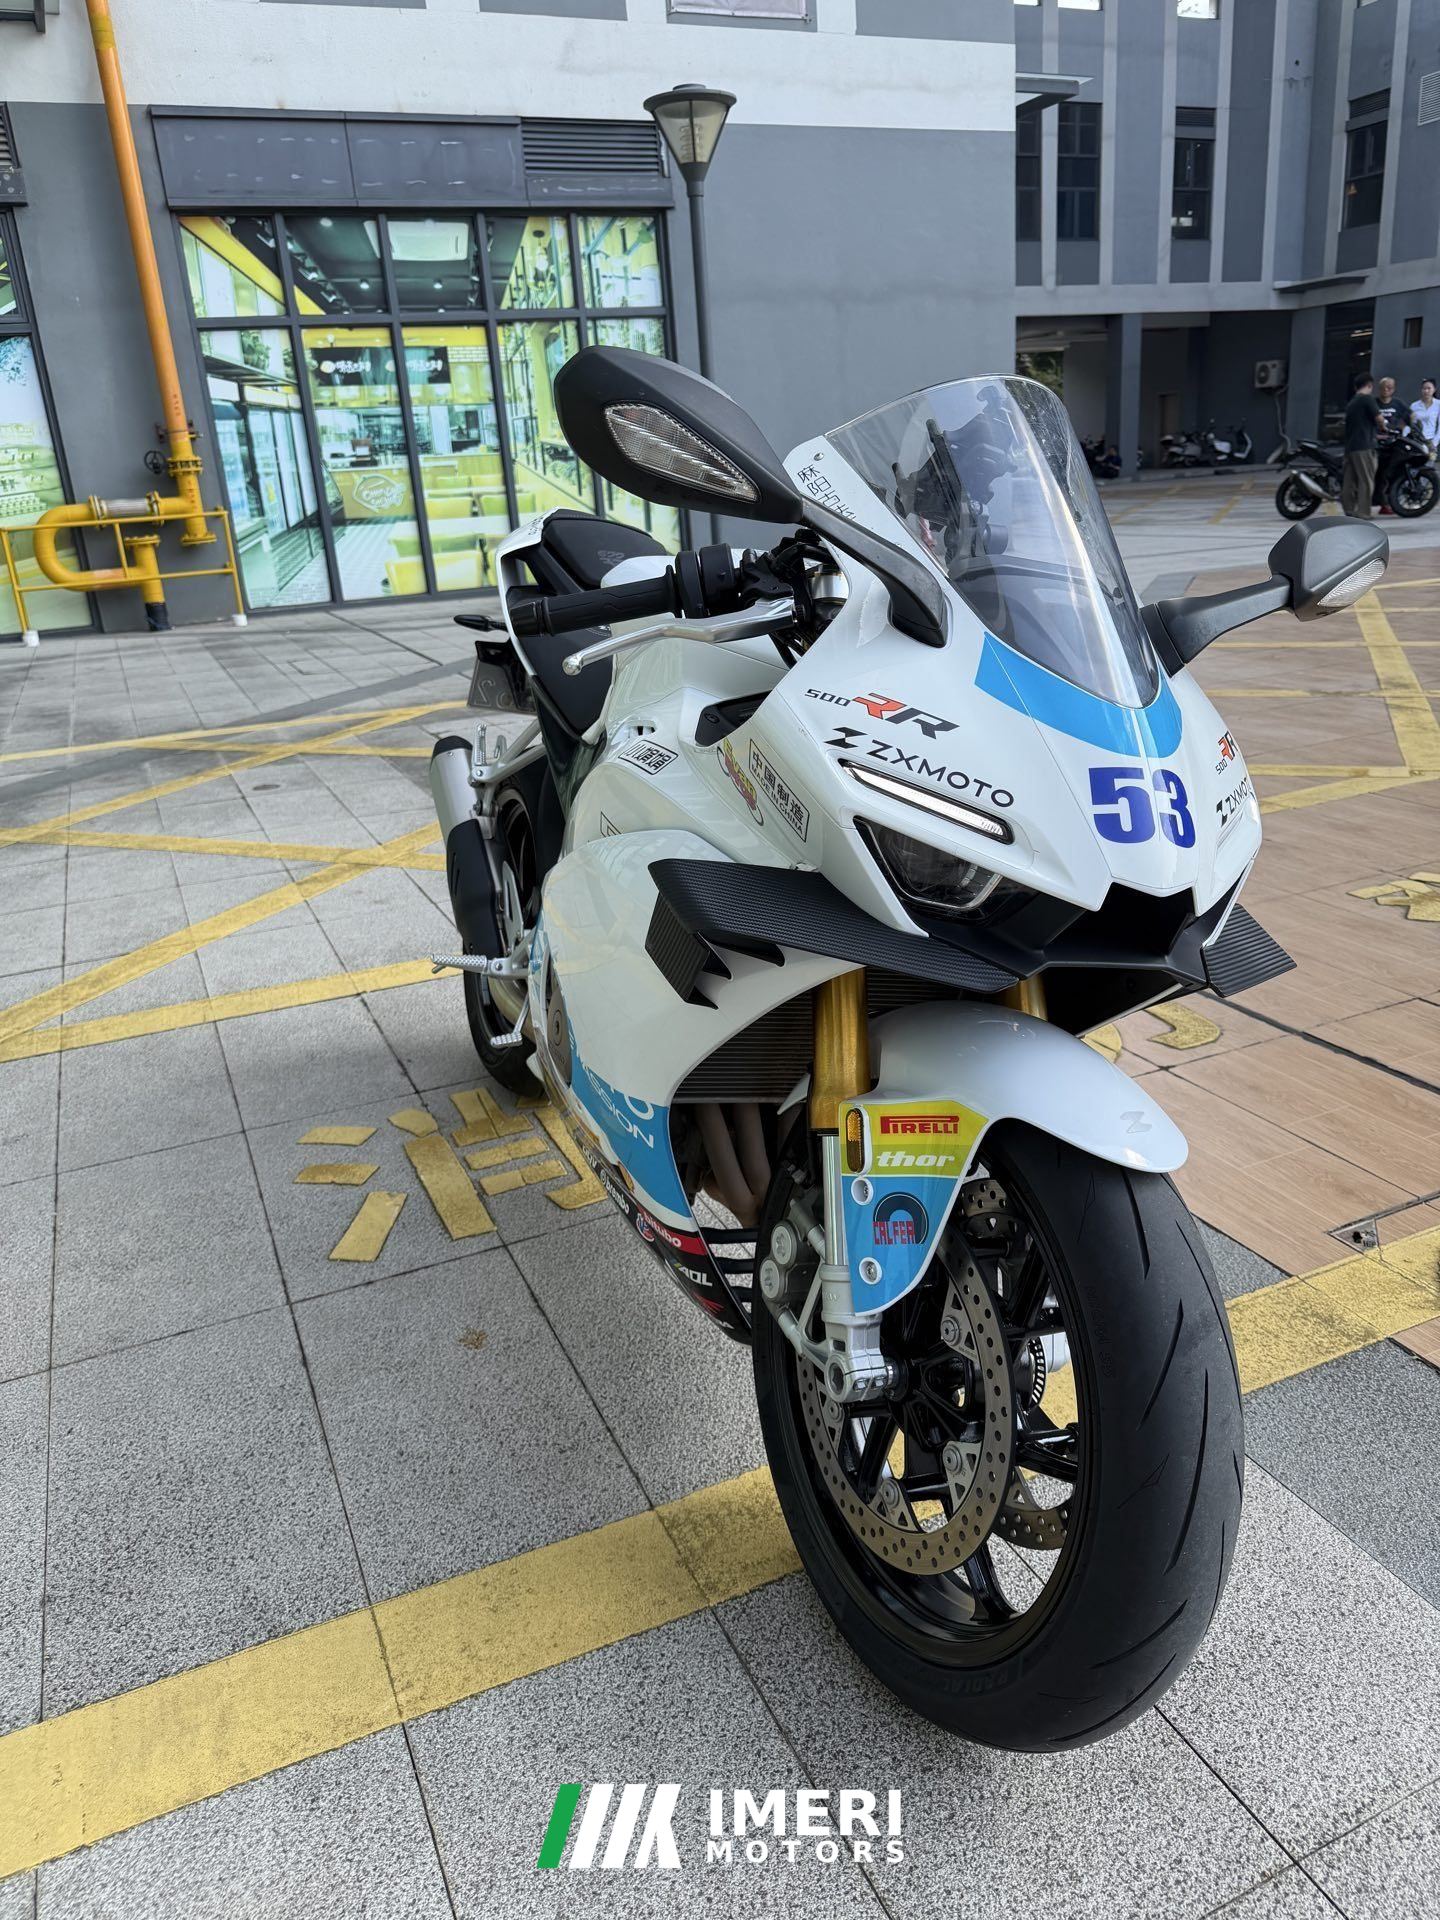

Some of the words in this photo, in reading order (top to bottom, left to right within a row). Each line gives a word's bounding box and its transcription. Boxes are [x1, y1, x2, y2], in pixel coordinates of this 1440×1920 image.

[751, 764, 771, 793] MADE
[779, 802, 803, 834] CHINA
[752, 750, 804, 825] 中国制造
[866, 739, 1014, 808] ZXMOTO
[1089, 769, 1195, 849] 53
[876, 1151, 956, 1167] thor
[880, 1115, 960, 1135] PIRELLI
[605, 1181, 630, 1215] brembo
